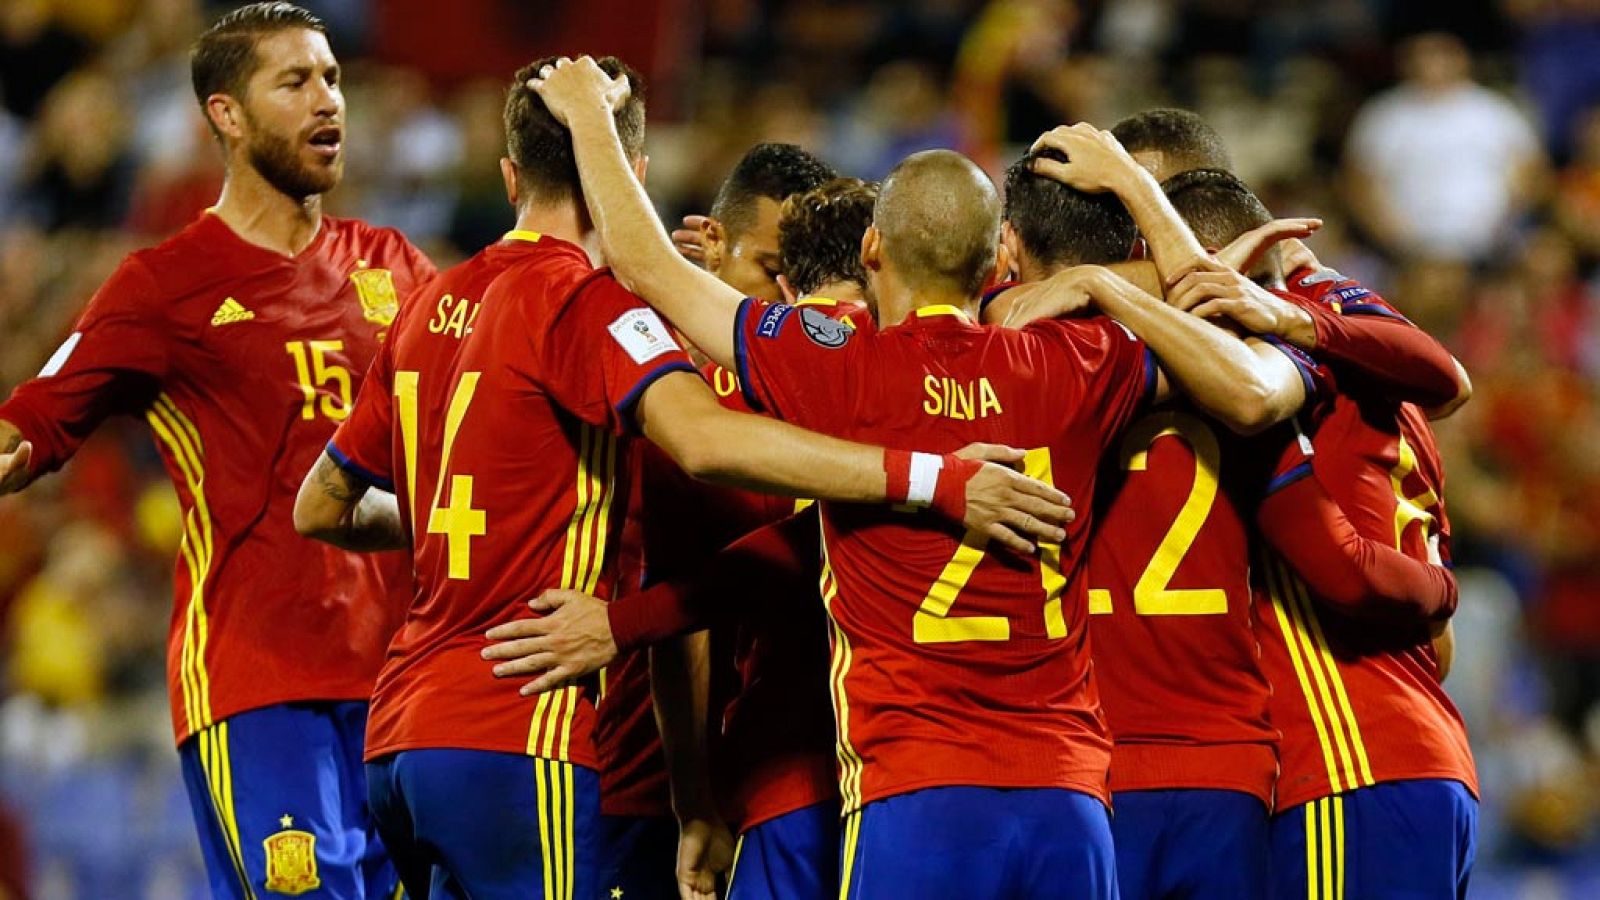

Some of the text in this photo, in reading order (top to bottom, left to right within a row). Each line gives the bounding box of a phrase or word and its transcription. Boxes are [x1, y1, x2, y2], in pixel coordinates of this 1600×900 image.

[286, 340, 352, 420] 15
[924, 374, 1003, 420] SILVA
[394, 371, 486, 580] 14
